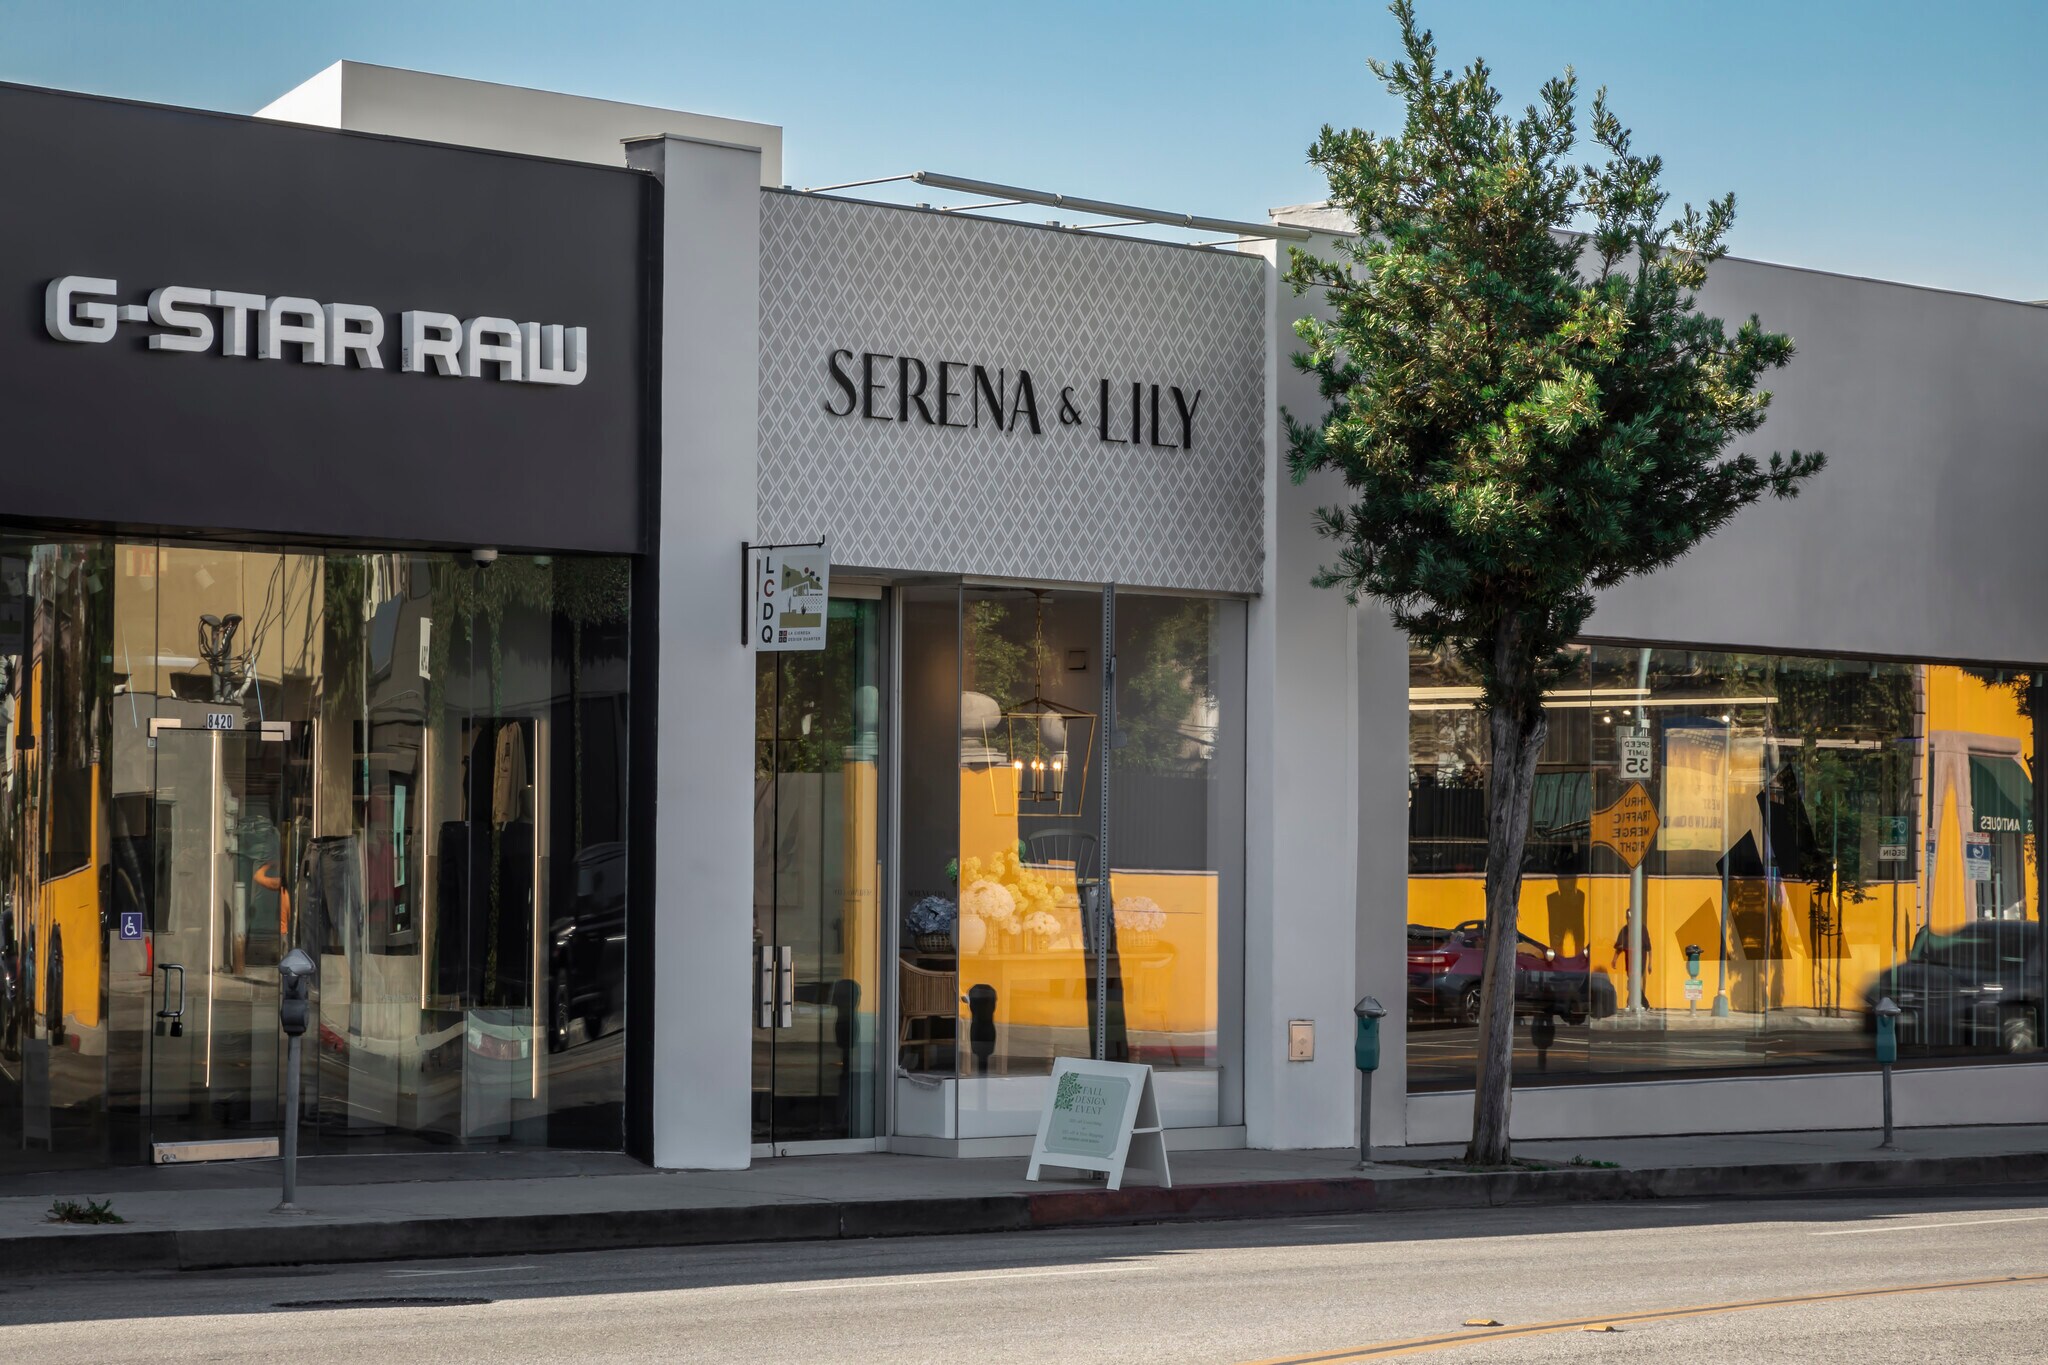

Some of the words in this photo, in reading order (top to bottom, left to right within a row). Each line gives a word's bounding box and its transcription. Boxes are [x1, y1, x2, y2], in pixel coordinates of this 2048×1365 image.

[45, 275, 384, 369] G-STAR
[401, 309, 588, 385] RAW
[824, 348, 1042, 435] SERENA
[1059, 386, 1083, 425] &
[1099, 378, 1202, 450] LILY
[208, 714, 233, 729] 8420
[1082, 1086, 1103, 1096] FALL
[1074, 1094, 1107, 1106] DESIGN
[1075, 1104, 1103, 1115] EVENT
